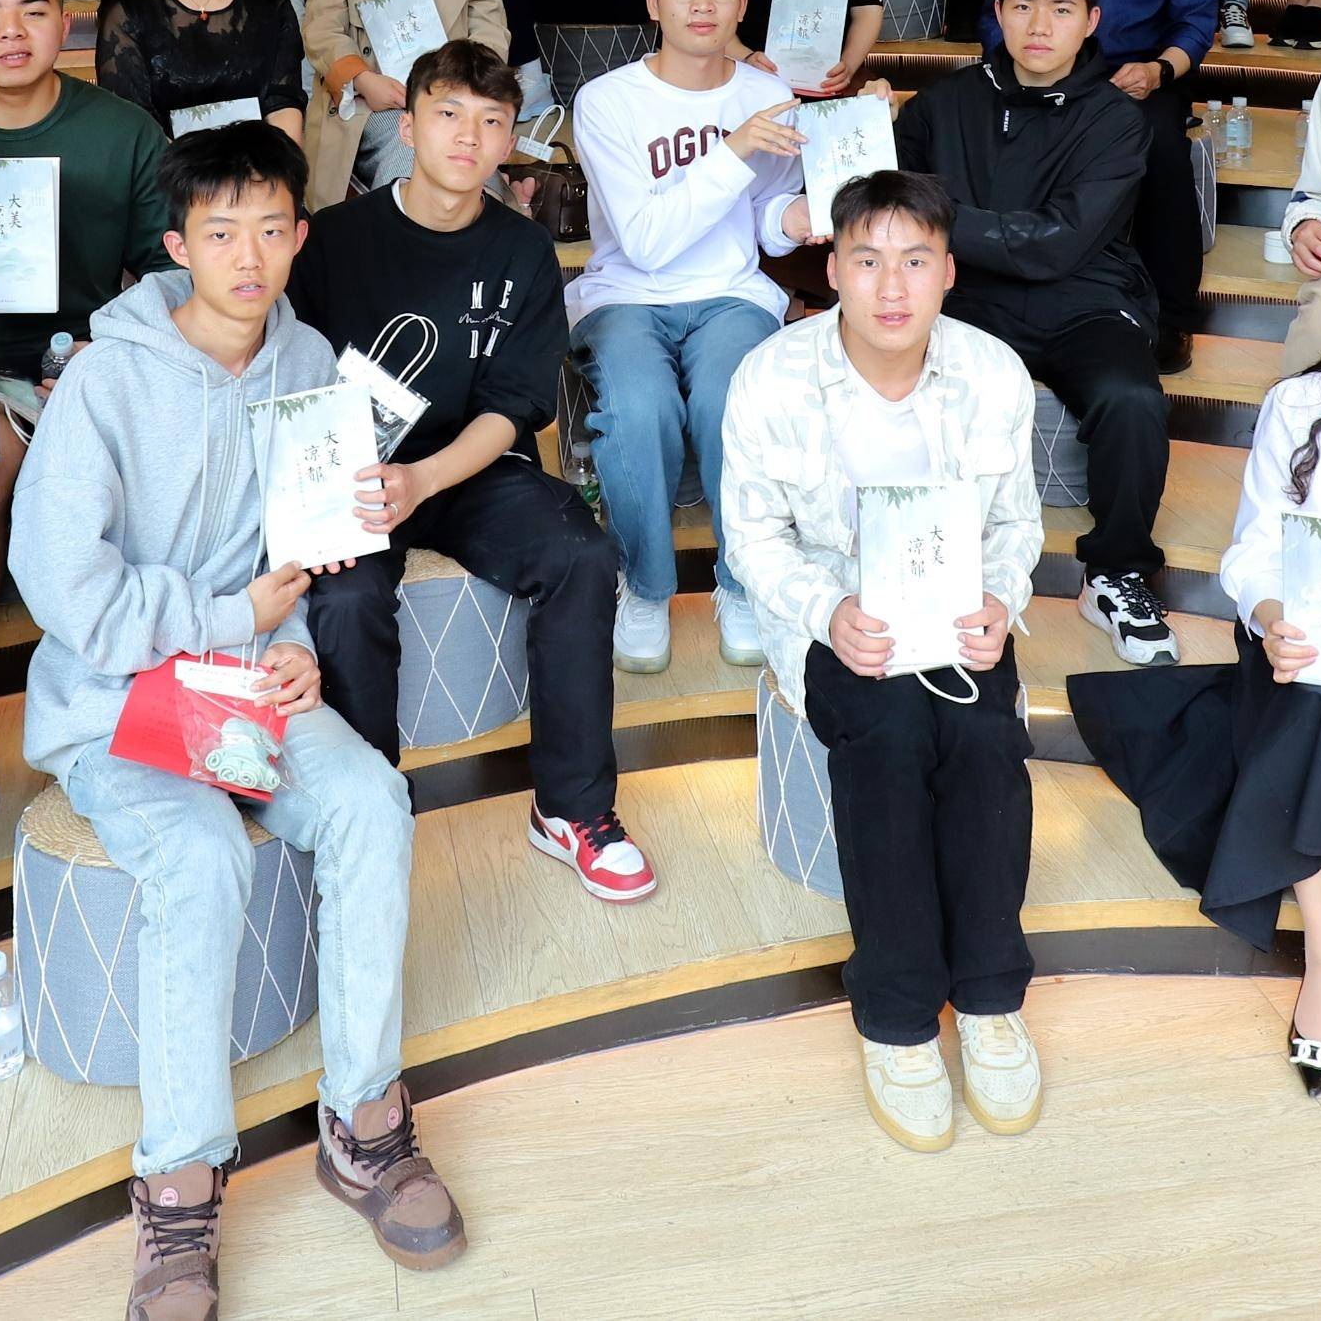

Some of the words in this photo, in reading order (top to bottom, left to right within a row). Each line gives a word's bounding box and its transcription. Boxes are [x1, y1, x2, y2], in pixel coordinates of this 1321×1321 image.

[406, 9, 421, 33] 大美
[811, 8, 822, 34] 大美
[852, 126, 867, 156] 大美
[8, 193, 23, 229] 大美
[323, 429, 342, 466] 大美
[929, 525, 946, 566] 大美
